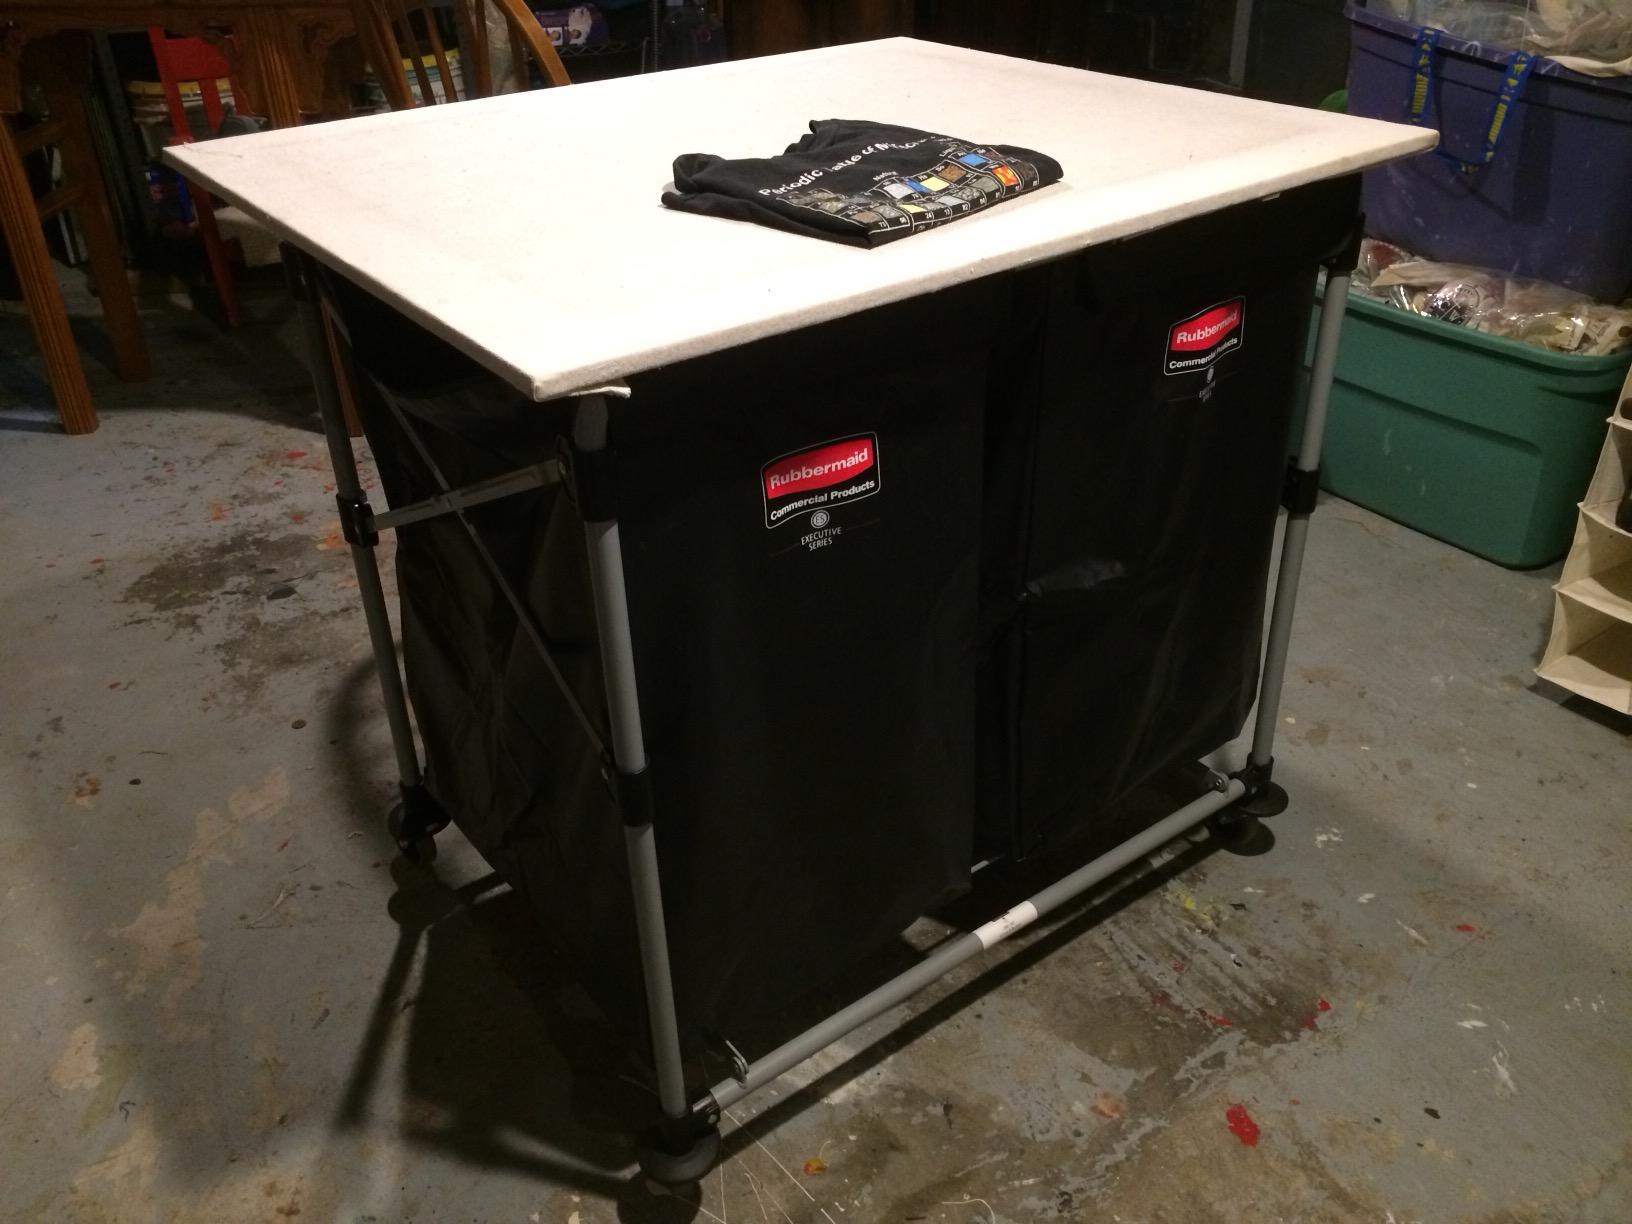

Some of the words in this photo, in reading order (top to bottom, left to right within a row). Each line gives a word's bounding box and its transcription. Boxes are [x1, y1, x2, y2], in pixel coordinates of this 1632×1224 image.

[758, 169, 823, 196] Periodic
[769, 447, 868, 490] Rubbermaid
[770, 493, 828, 521] Commercial
[830, 480, 875, 500] Products
[801, 526, 842, 546] EXECUTIVE
[808, 537, 833, 551] SERIES
